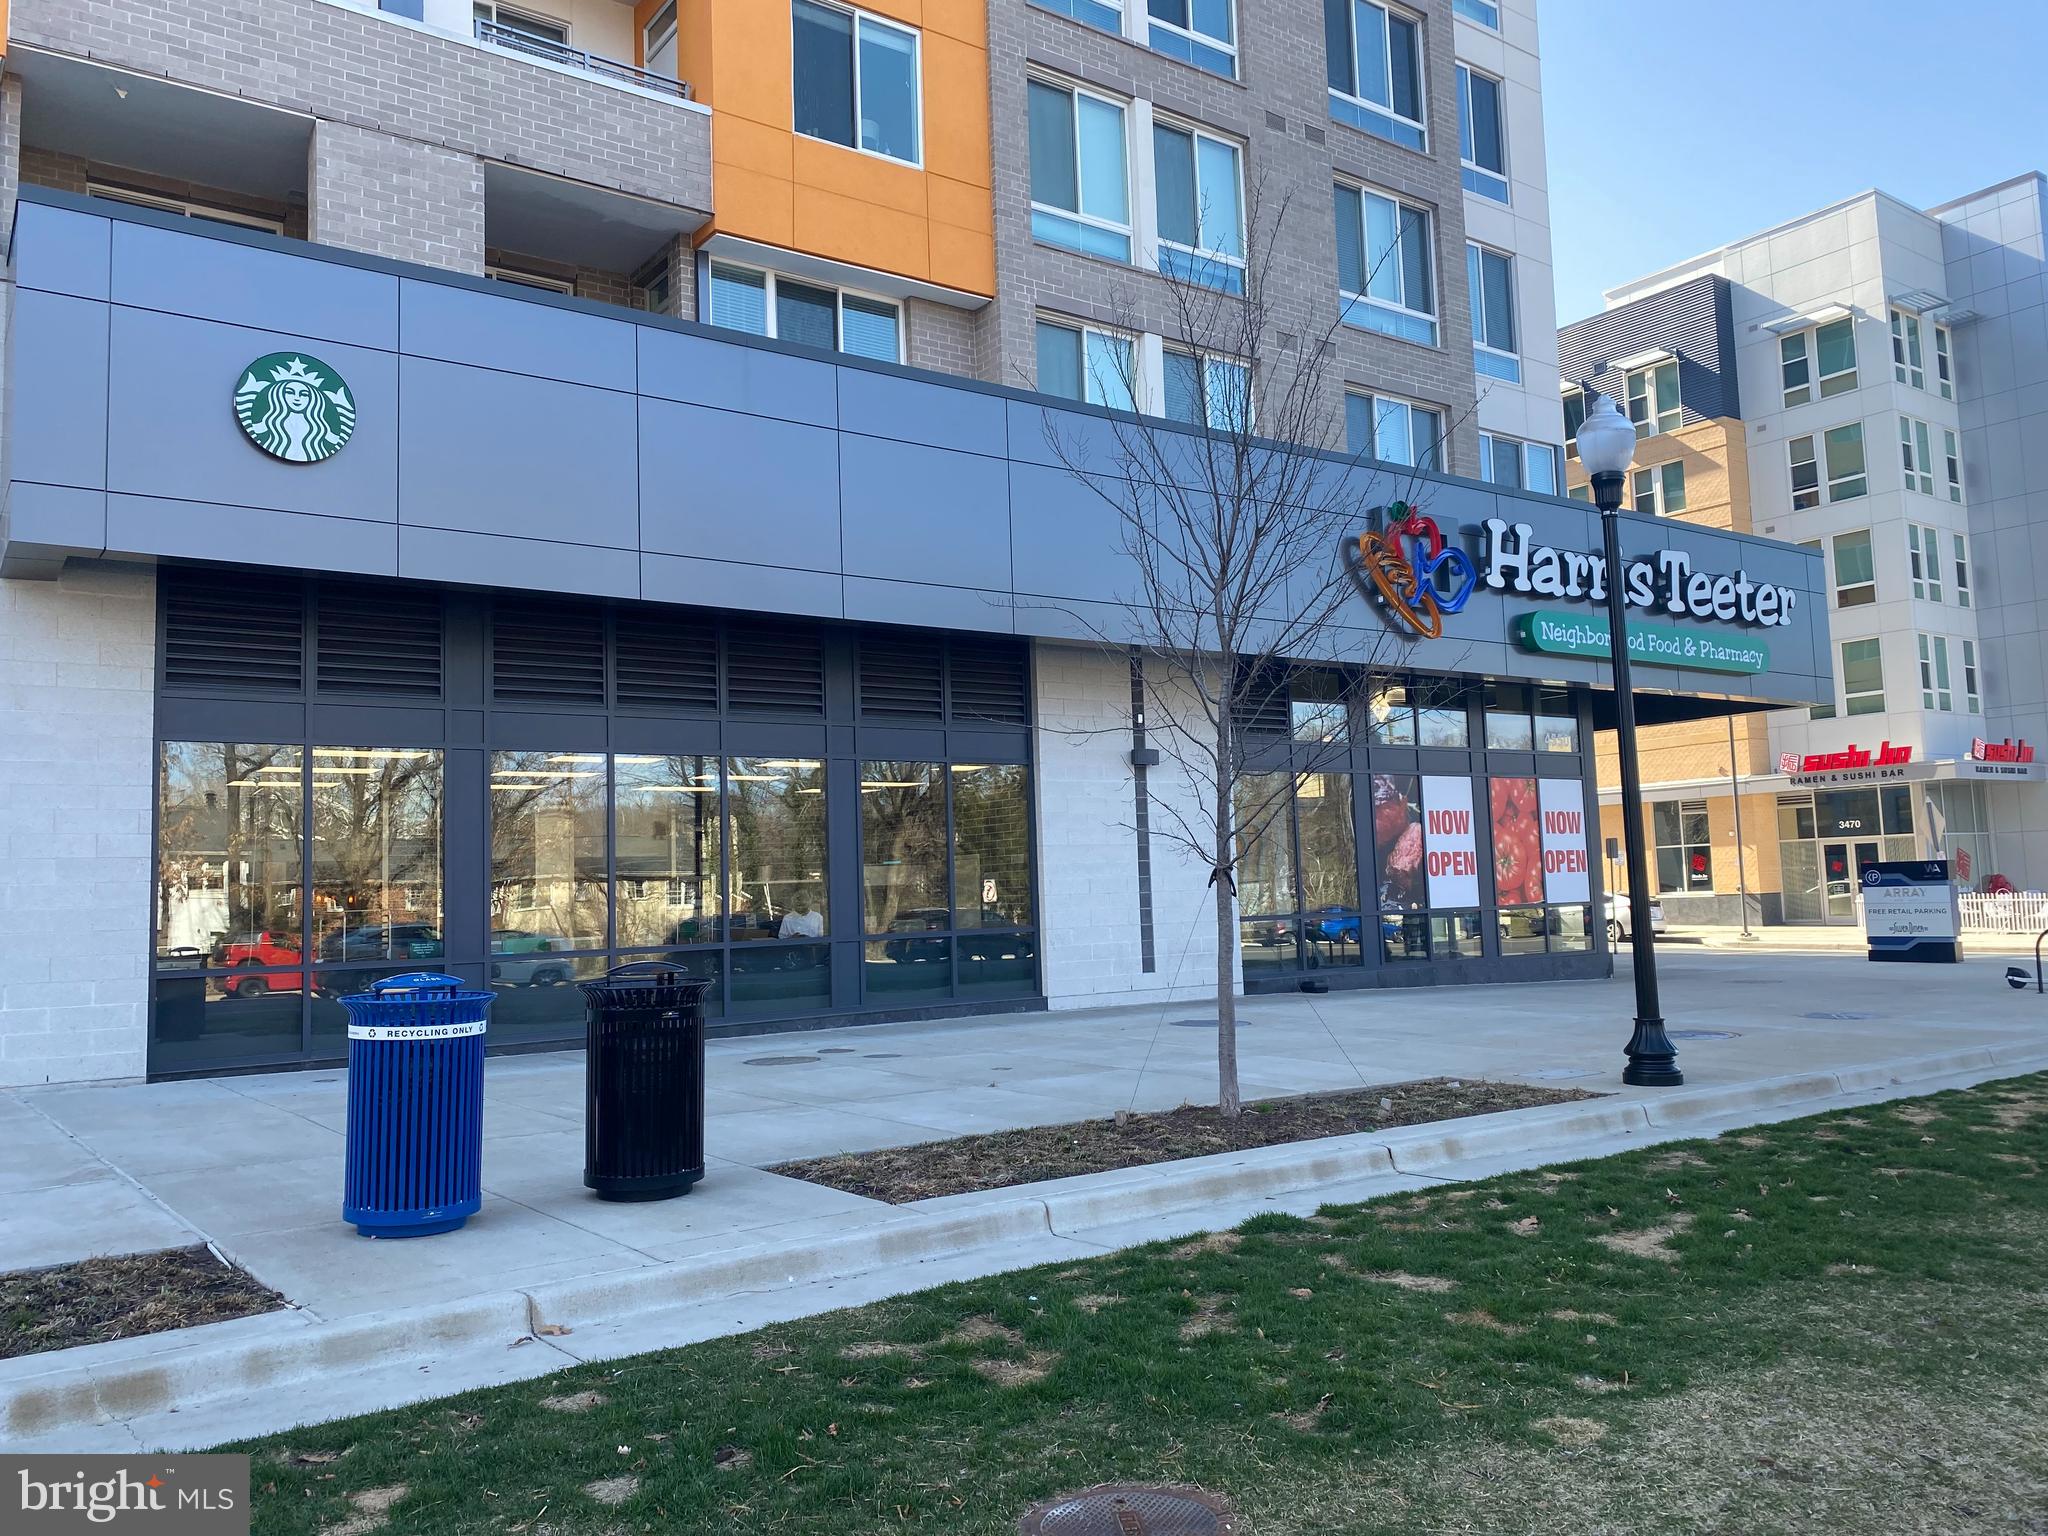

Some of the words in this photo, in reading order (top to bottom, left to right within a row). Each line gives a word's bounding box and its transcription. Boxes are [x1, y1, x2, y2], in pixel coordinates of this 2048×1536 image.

[1658, 549, 1796, 627] Teeter
[1541, 620, 1645, 650] Neighborod
[1648, 634, 1681, 655] Food
[1684, 637, 1696, 656] &
[1700, 640, 1763, 668] Pharmacy
[1790, 775, 1826, 785] RAMEN
[1843, 771, 1876, 780] SUSHI
[1881, 769, 1904, 777] BAR
[1428, 810, 1470, 835] NOW
[1545, 810, 1581, 834] NOW
[1838, 819, 1861, 829] 3470
[1427, 851, 1476, 876] OPEN
[1545, 850, 1586, 873] OPEN
[1884, 887, 1927, 898] ARRAY
[387, 1027, 448, 1038] RECYCLING
[452, 1026, 473, 1035] ONLY
